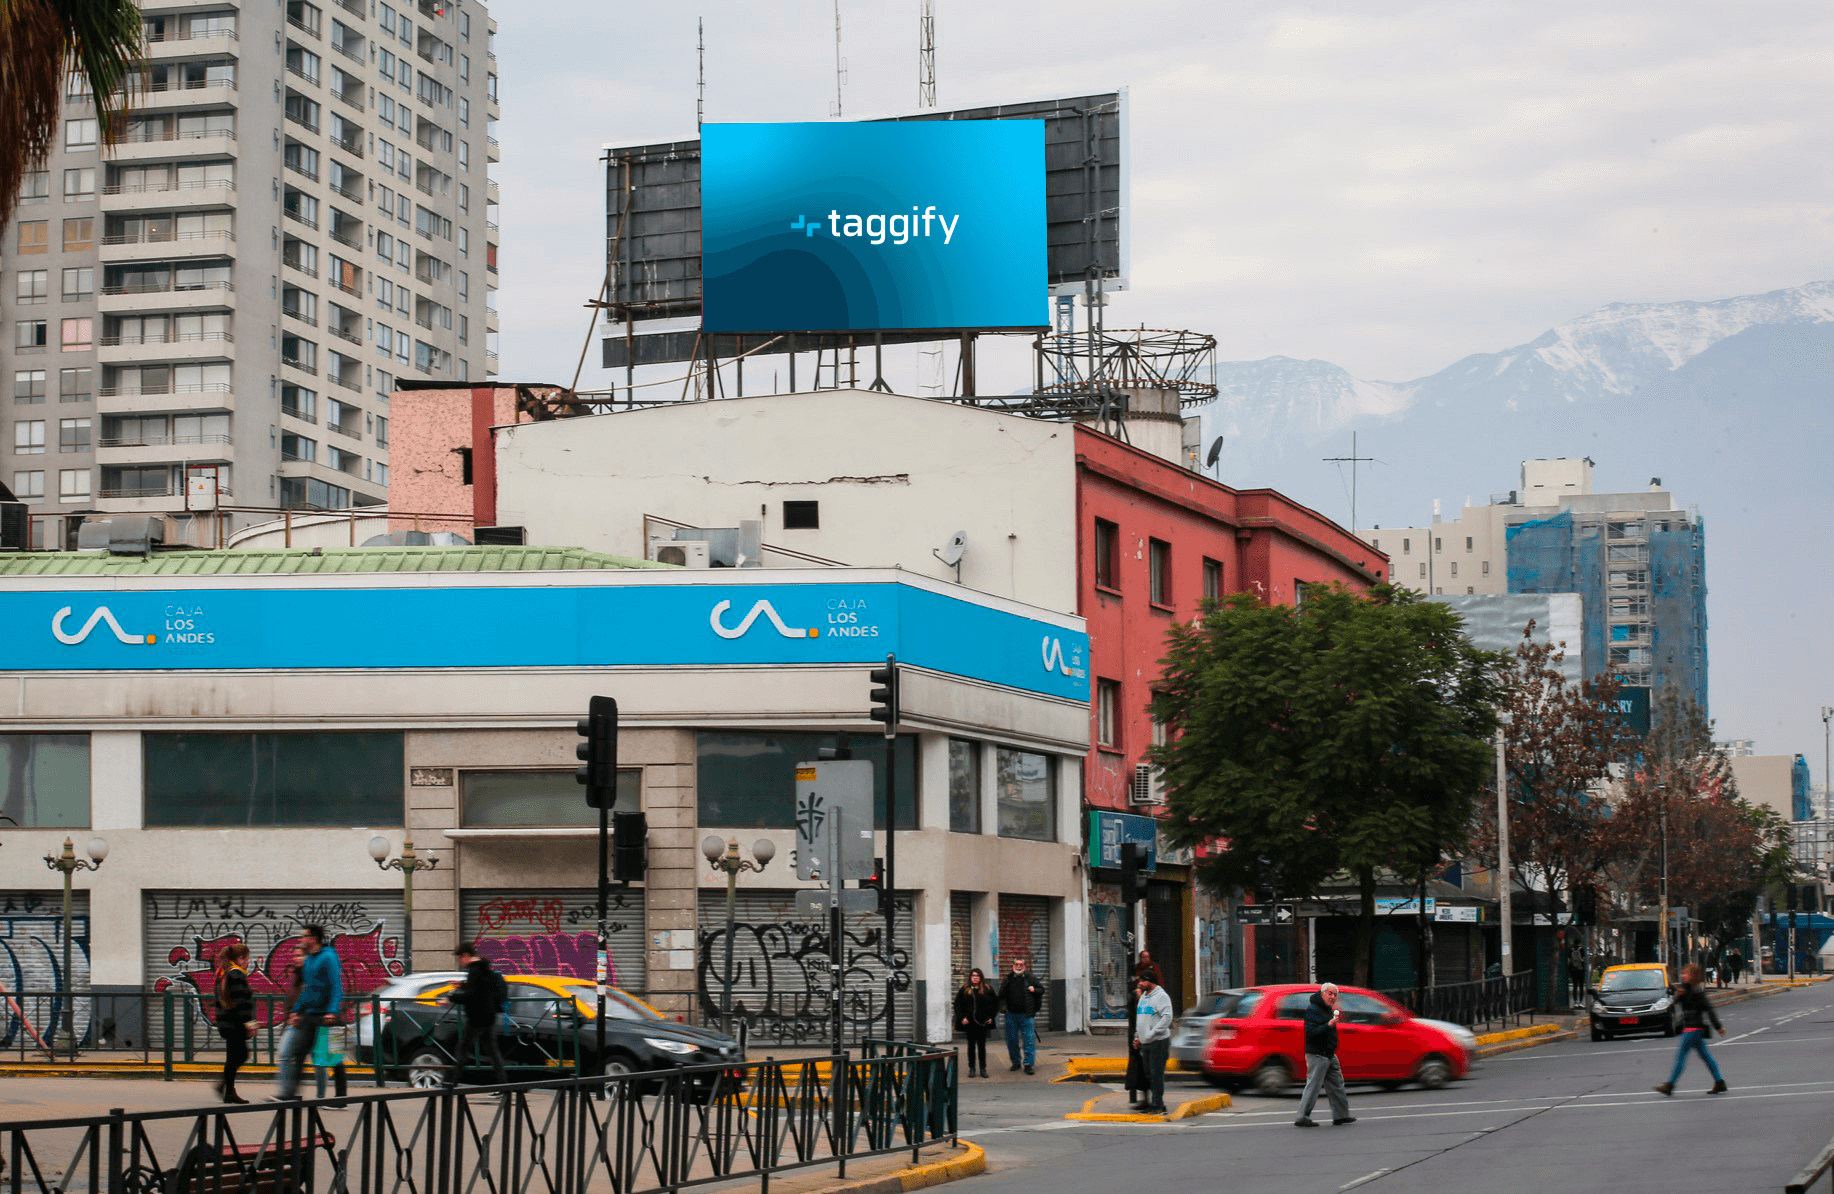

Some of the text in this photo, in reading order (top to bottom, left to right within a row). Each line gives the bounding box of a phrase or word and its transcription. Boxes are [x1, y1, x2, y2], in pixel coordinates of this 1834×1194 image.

[827, 205, 960, 245] taggify
[826, 599, 867, 610] CAJA
[164, 605, 204, 617] CAJA
[827, 612, 858, 624] LOS
[165, 619, 195, 631] LOS
[827, 626, 879, 637] ANDES
[165, 632, 215, 644] ANDES
